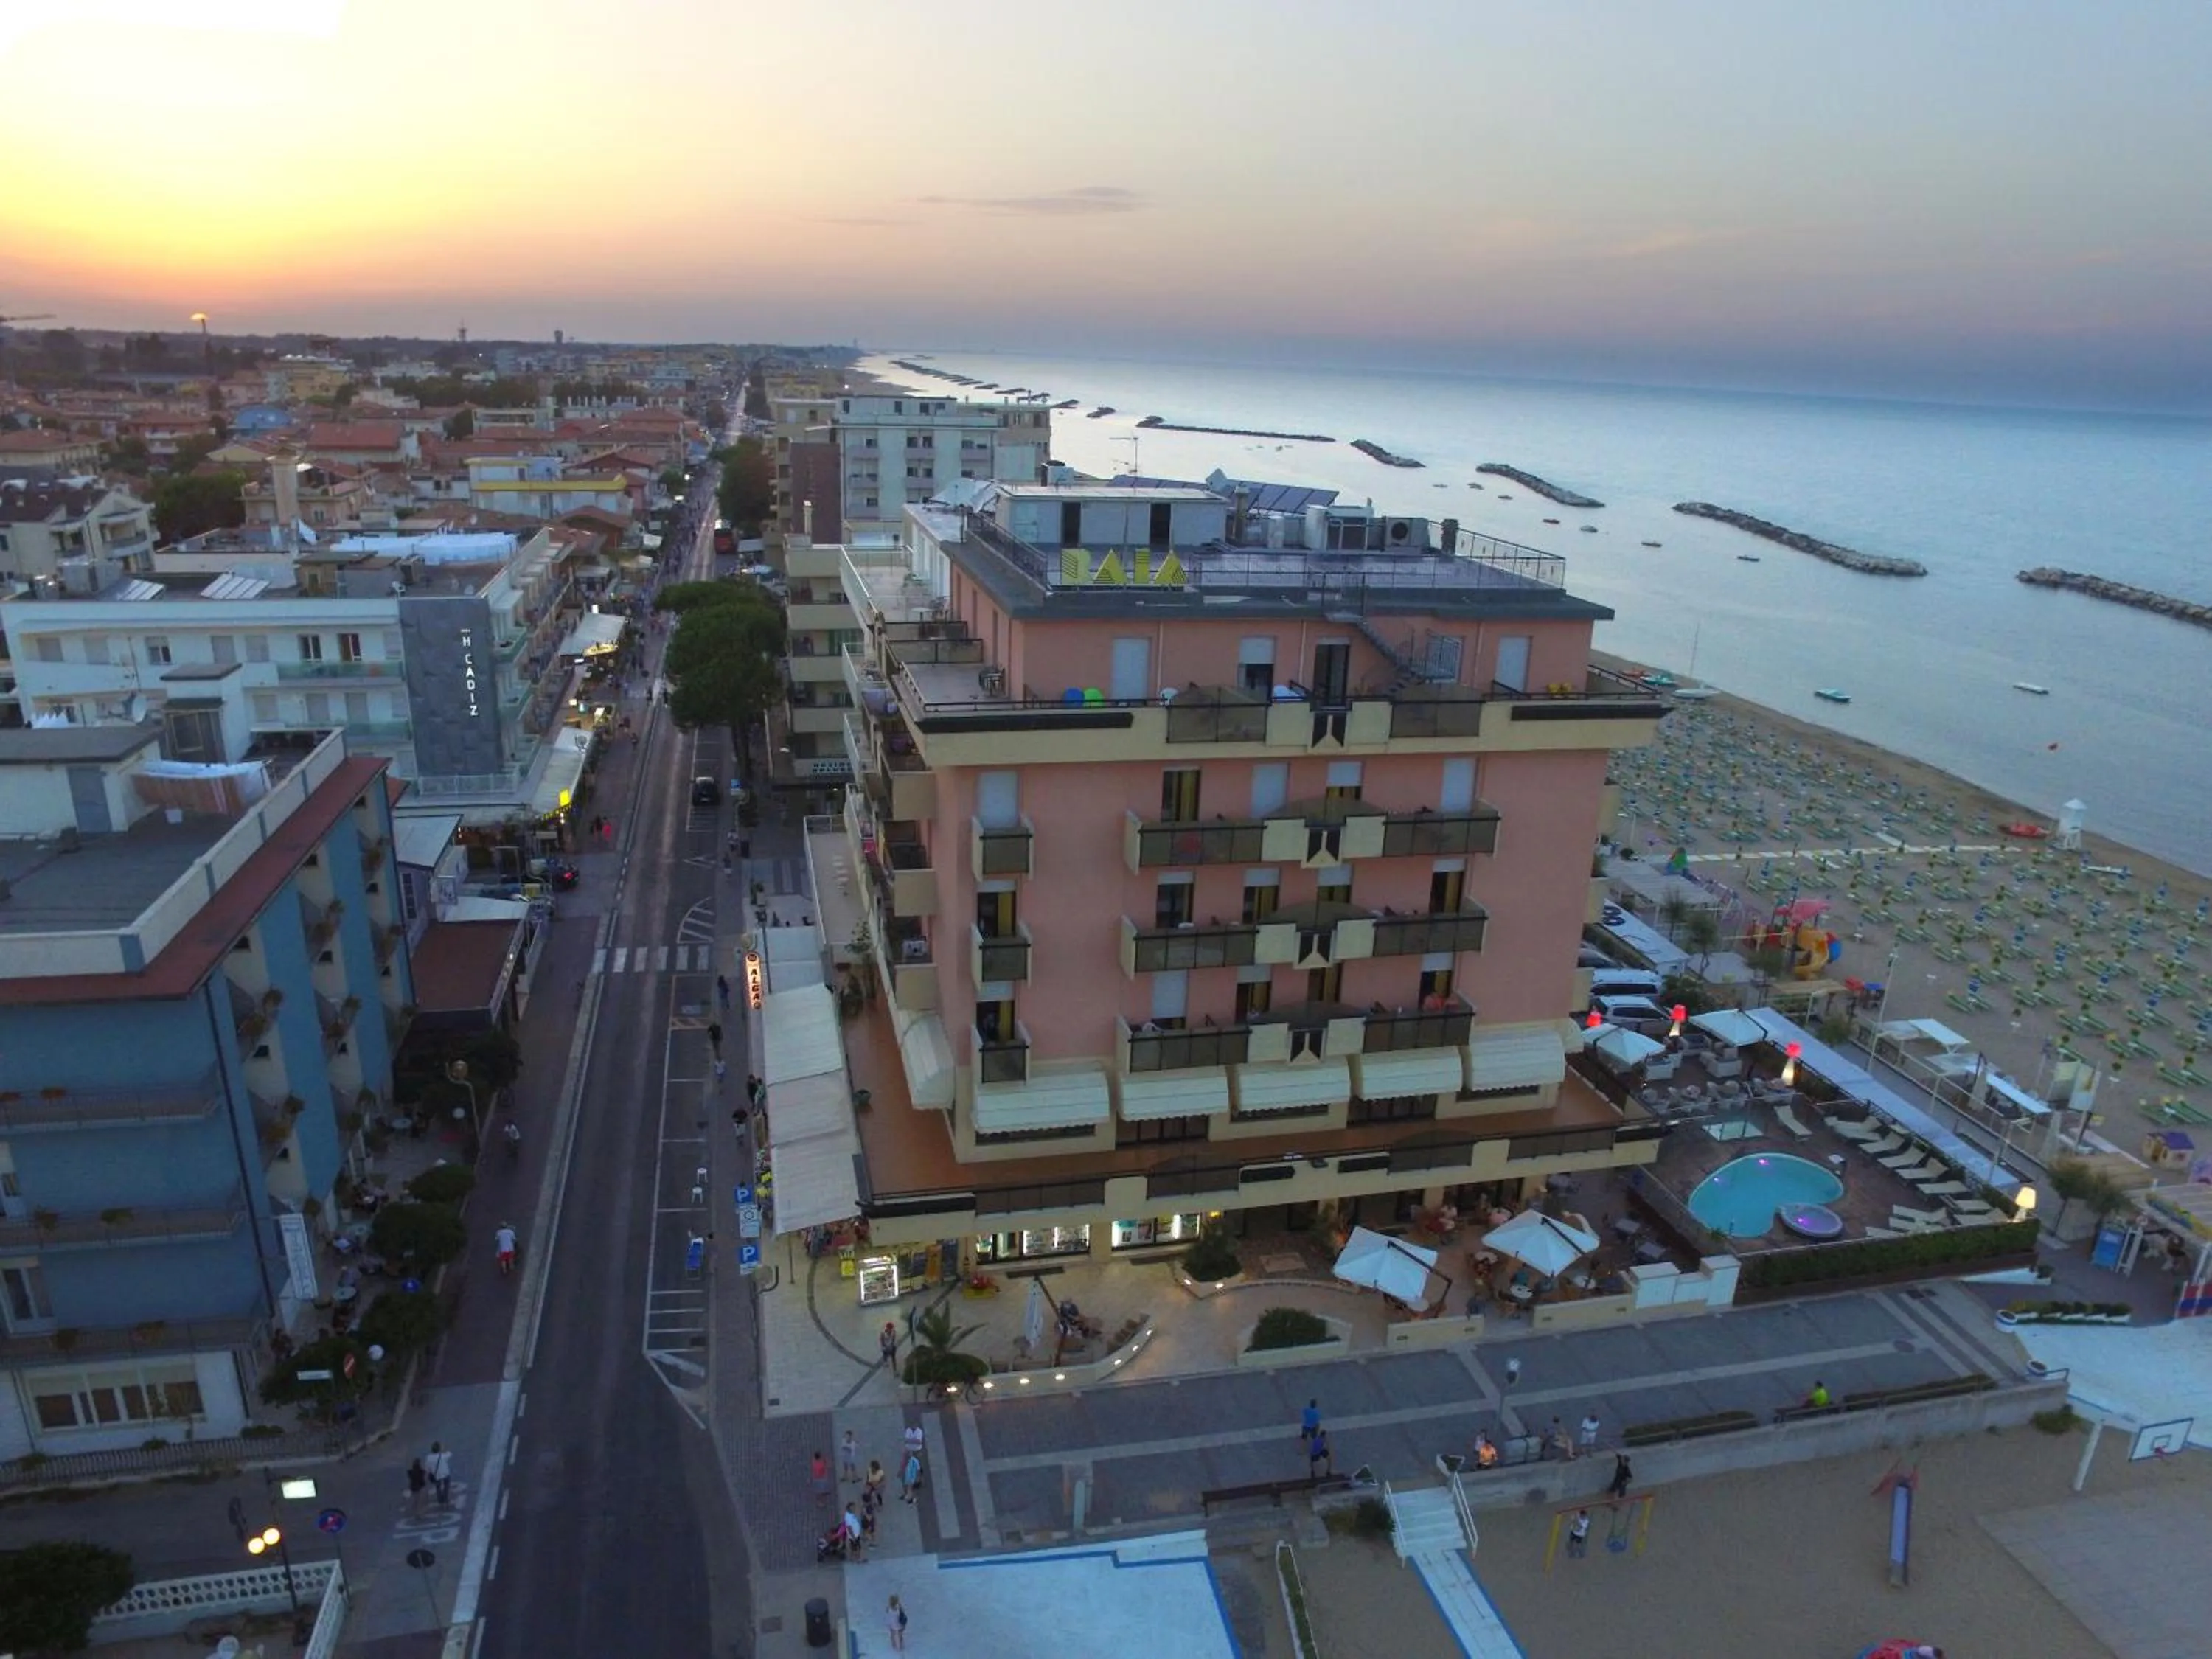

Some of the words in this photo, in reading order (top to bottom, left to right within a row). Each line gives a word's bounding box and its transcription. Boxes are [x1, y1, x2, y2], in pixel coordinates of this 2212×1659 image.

[462, 636, 471, 647] H
[465, 654, 479, 716] CADIZ
[737, 1188, 750, 1203] P
[742, 1246, 755, 1262] P
